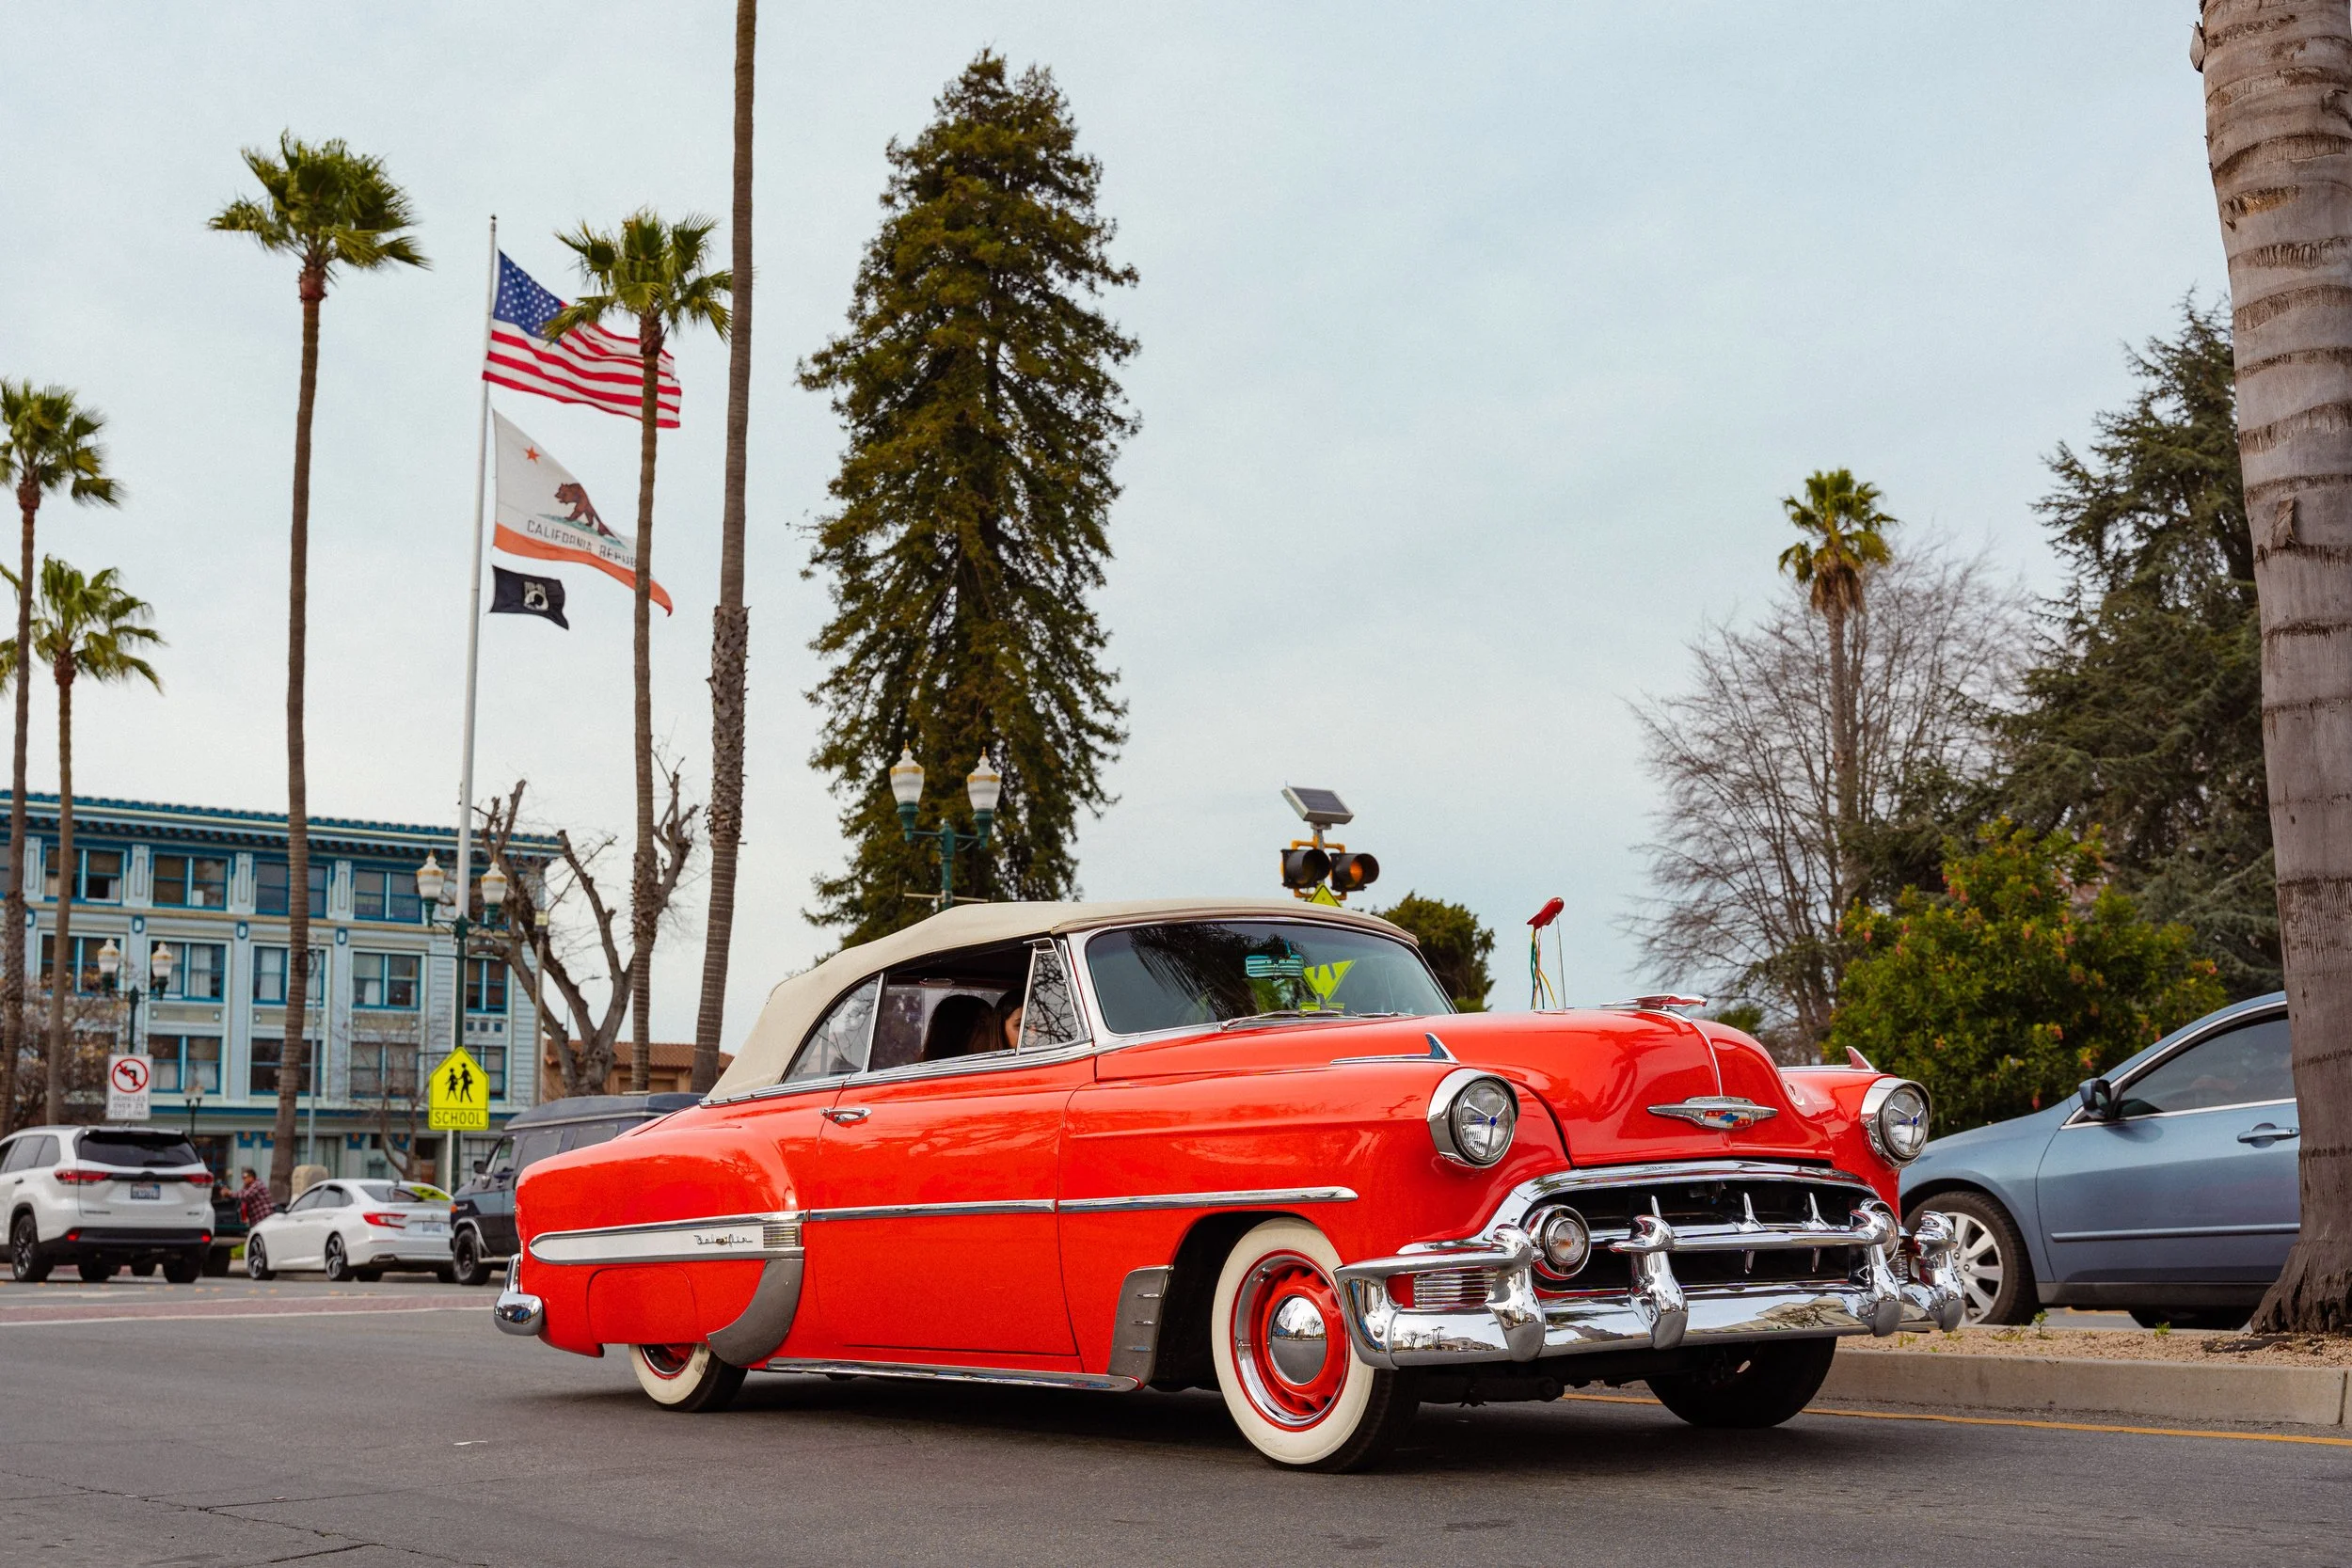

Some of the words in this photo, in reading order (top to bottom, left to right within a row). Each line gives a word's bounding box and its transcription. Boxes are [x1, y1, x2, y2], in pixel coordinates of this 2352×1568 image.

[527, 519, 593, 551] CALIFORNIA
[599, 544, 637, 567] REPUB
[435, 1111, 483, 1125] SCHOOL
